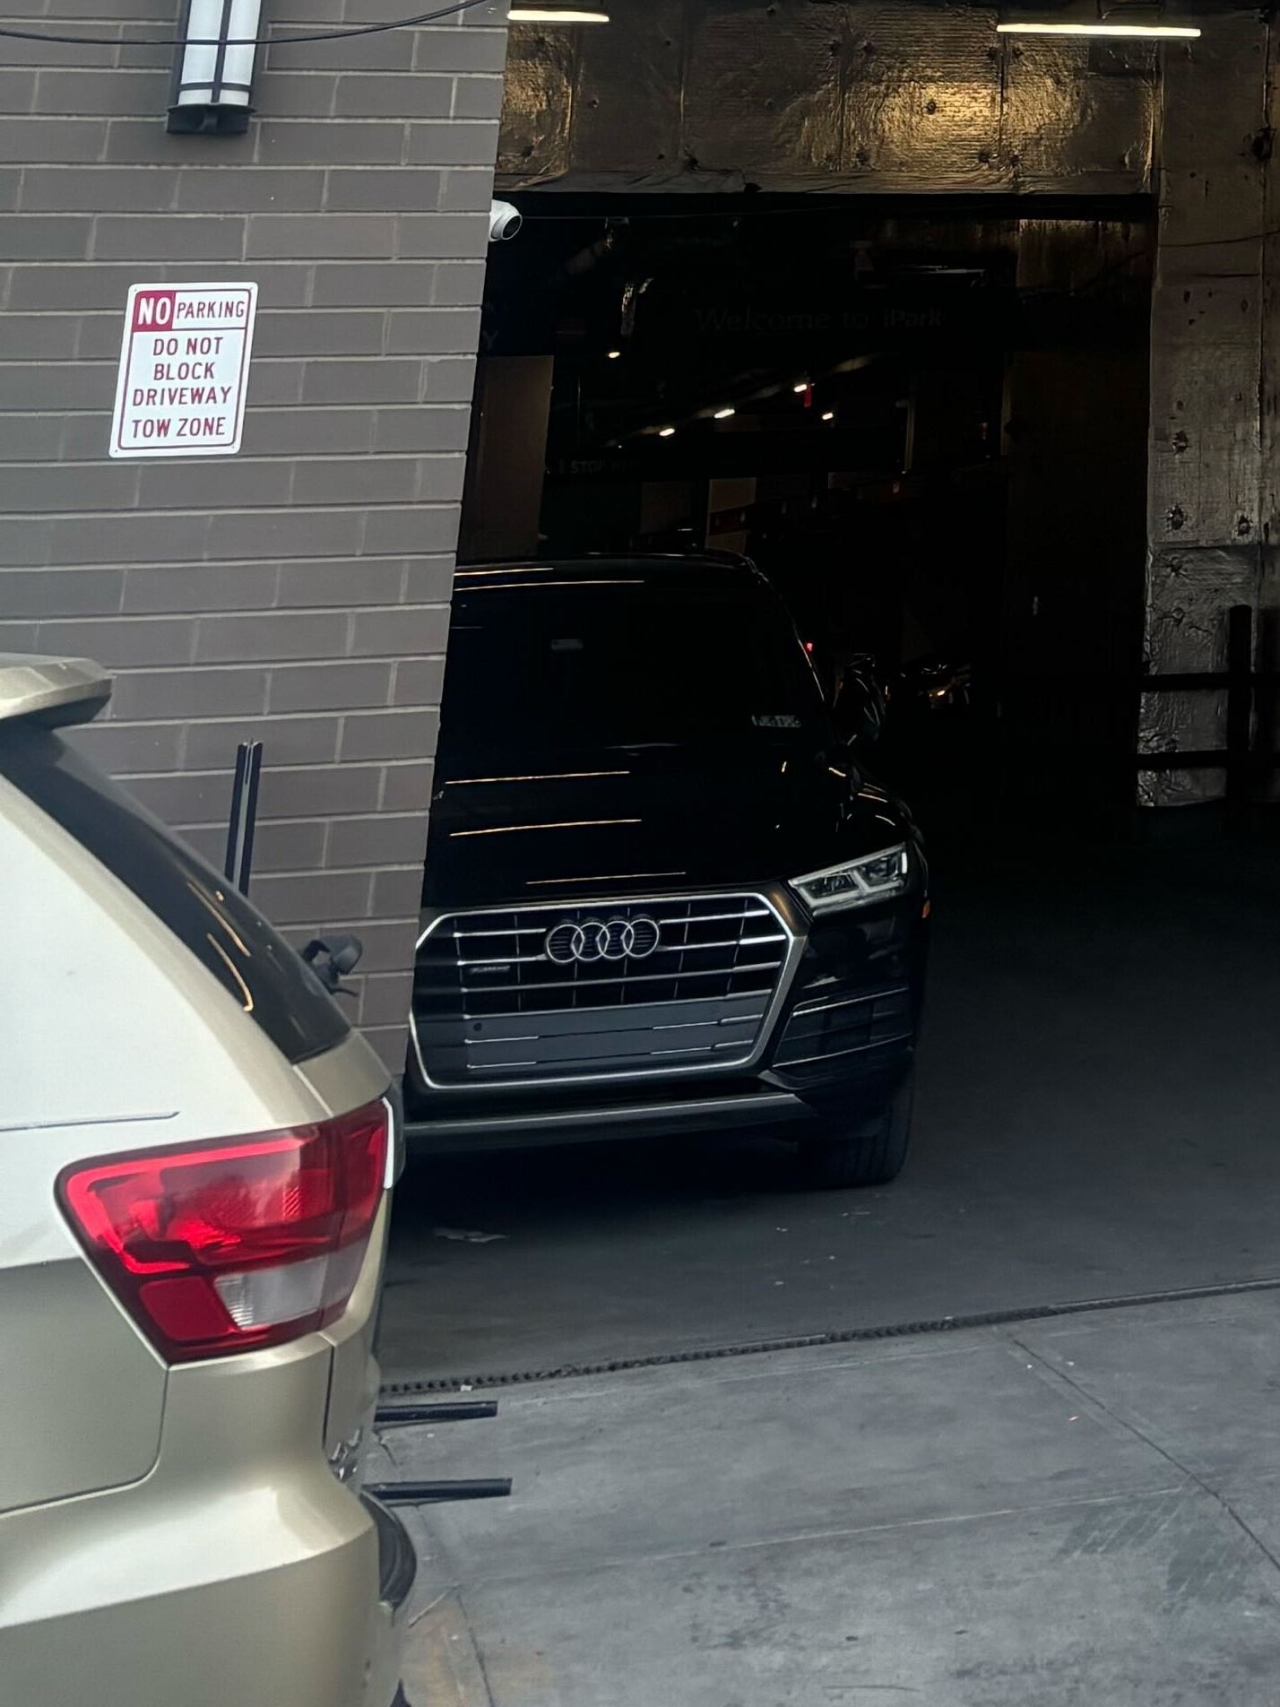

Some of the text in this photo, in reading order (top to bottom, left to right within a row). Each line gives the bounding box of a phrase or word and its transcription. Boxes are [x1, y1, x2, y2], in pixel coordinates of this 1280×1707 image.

[136, 296, 245, 326] NO PARKING
[152, 336, 224, 356] DO NOT
[153, 361, 215, 381] BLOCK
[132, 386, 232, 407] DRIVEWAY
[132, 416, 226, 439] TOW ZONE
